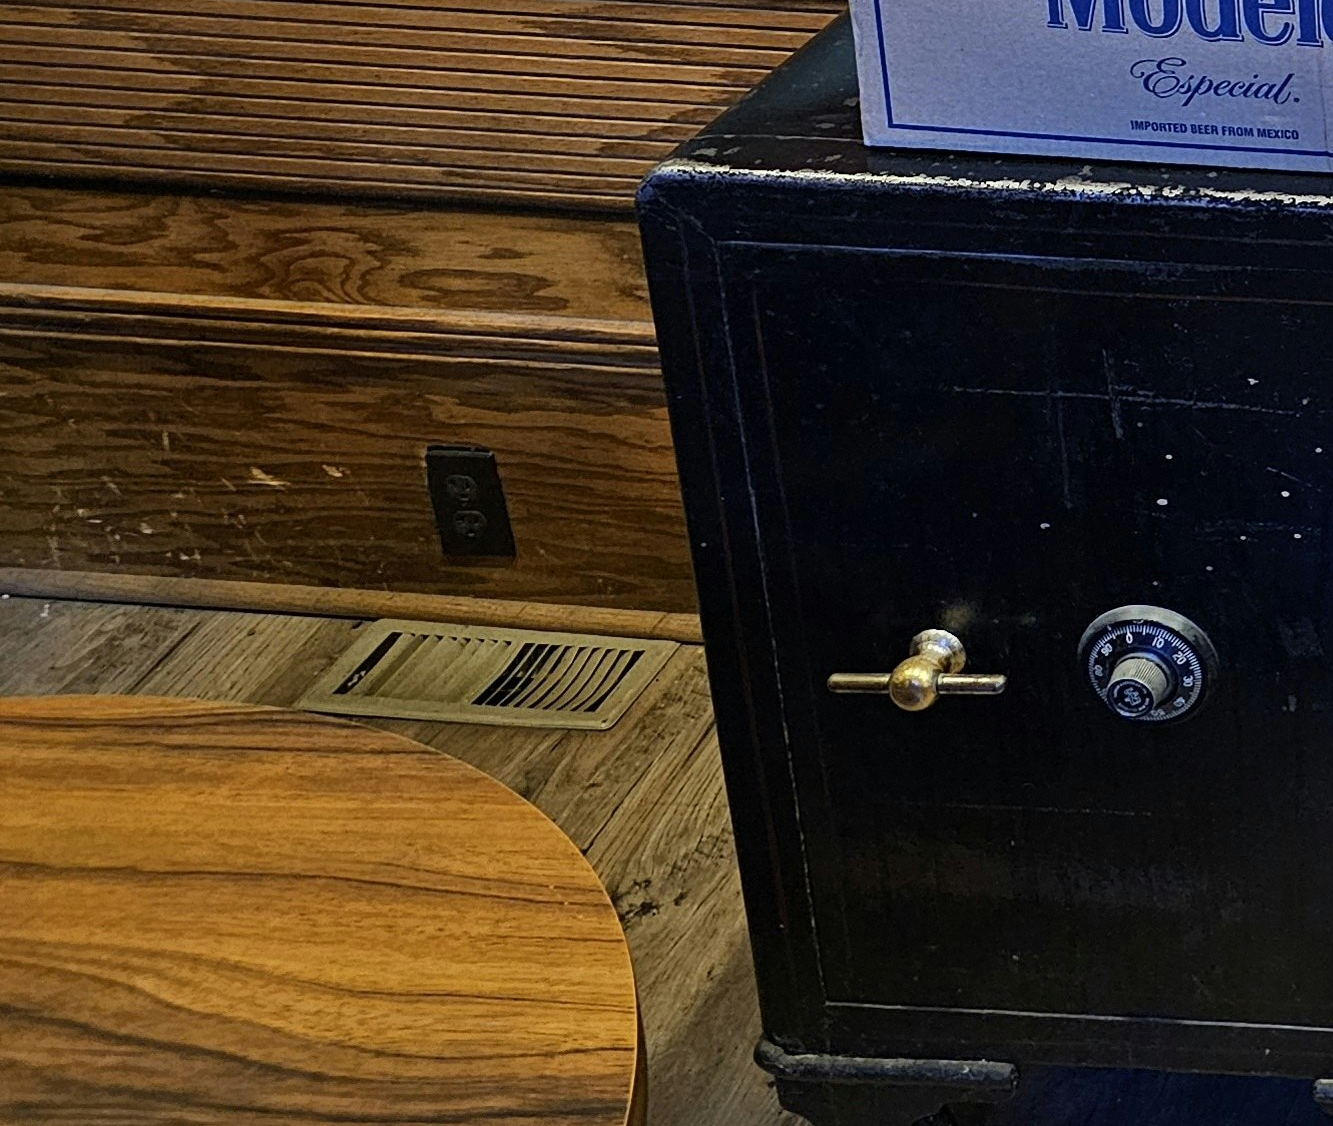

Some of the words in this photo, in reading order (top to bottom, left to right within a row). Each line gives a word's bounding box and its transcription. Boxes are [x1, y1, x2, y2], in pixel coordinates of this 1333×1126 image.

[1130, 120, 1188, 134] IMPORTED
[1190, 124, 1219, 136] BEER
[1222, 125, 1254, 137] FROM
[1257, 127, 1299, 140] MEXICO
[1126, 633, 1133, 644] 0
[1152, 638, 1165, 648] 10
[1101, 642, 1113, 656] 90
[1172, 651, 1187, 665] 20
[1183, 675, 1194, 687] 30
